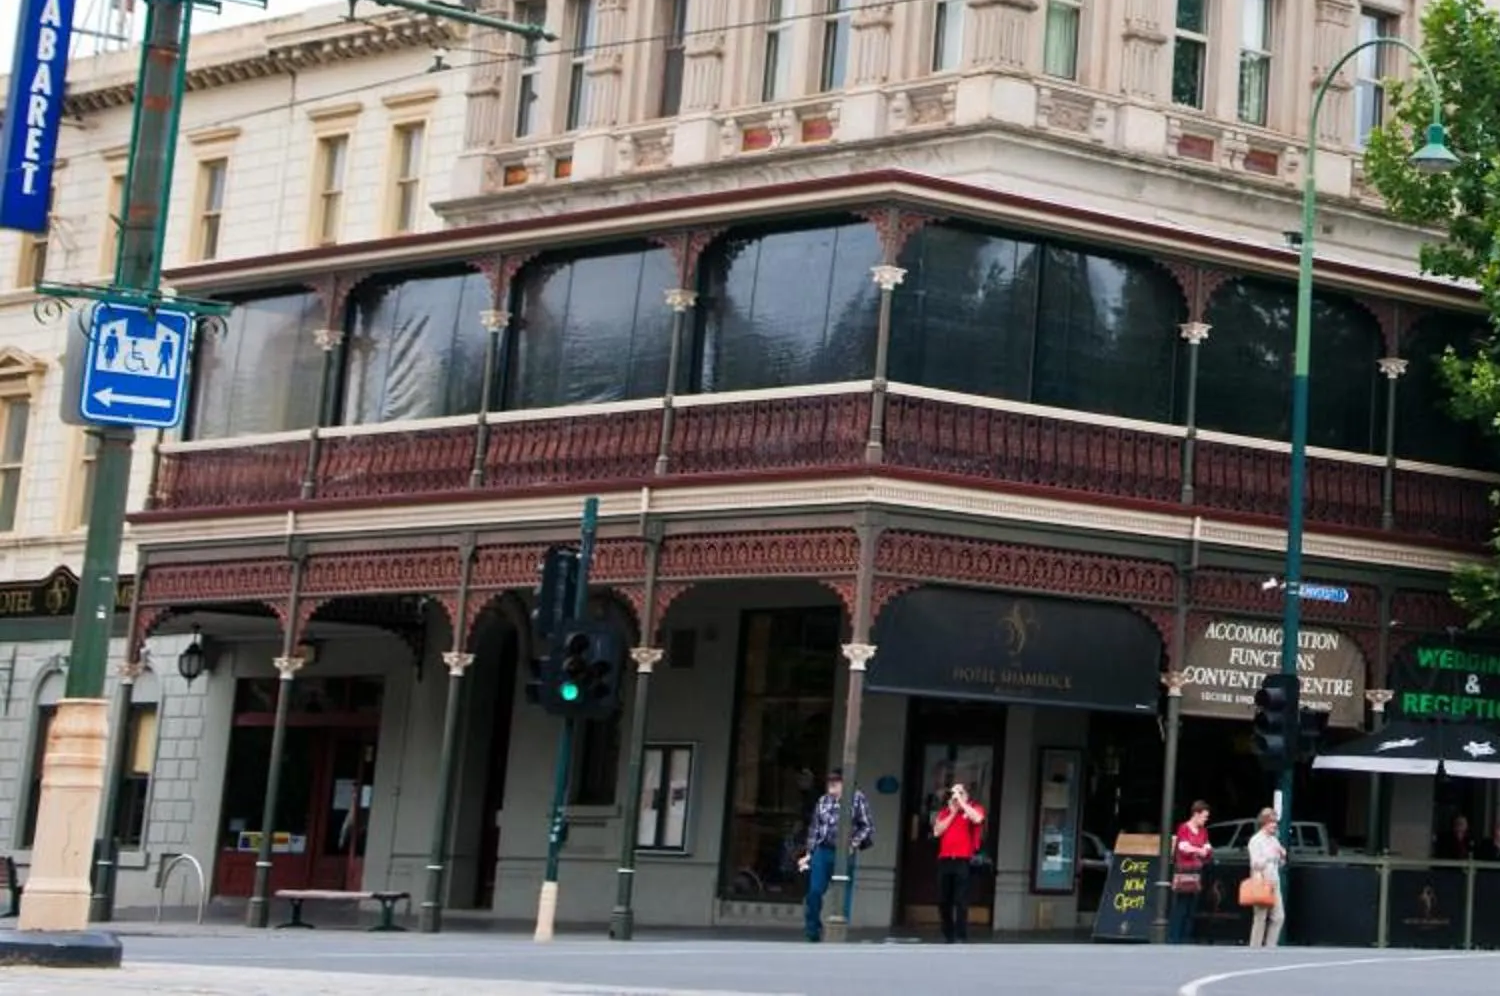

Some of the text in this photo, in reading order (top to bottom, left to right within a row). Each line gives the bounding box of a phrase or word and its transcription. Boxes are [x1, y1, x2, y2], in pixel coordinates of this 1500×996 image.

[1206, 623, 1338, 649] ACCOMMOTION
[1229, 647, 1315, 671] FUNCTNS
[1183, 665, 1266, 689] CONVENT
[1465, 674, 1481, 694] &
